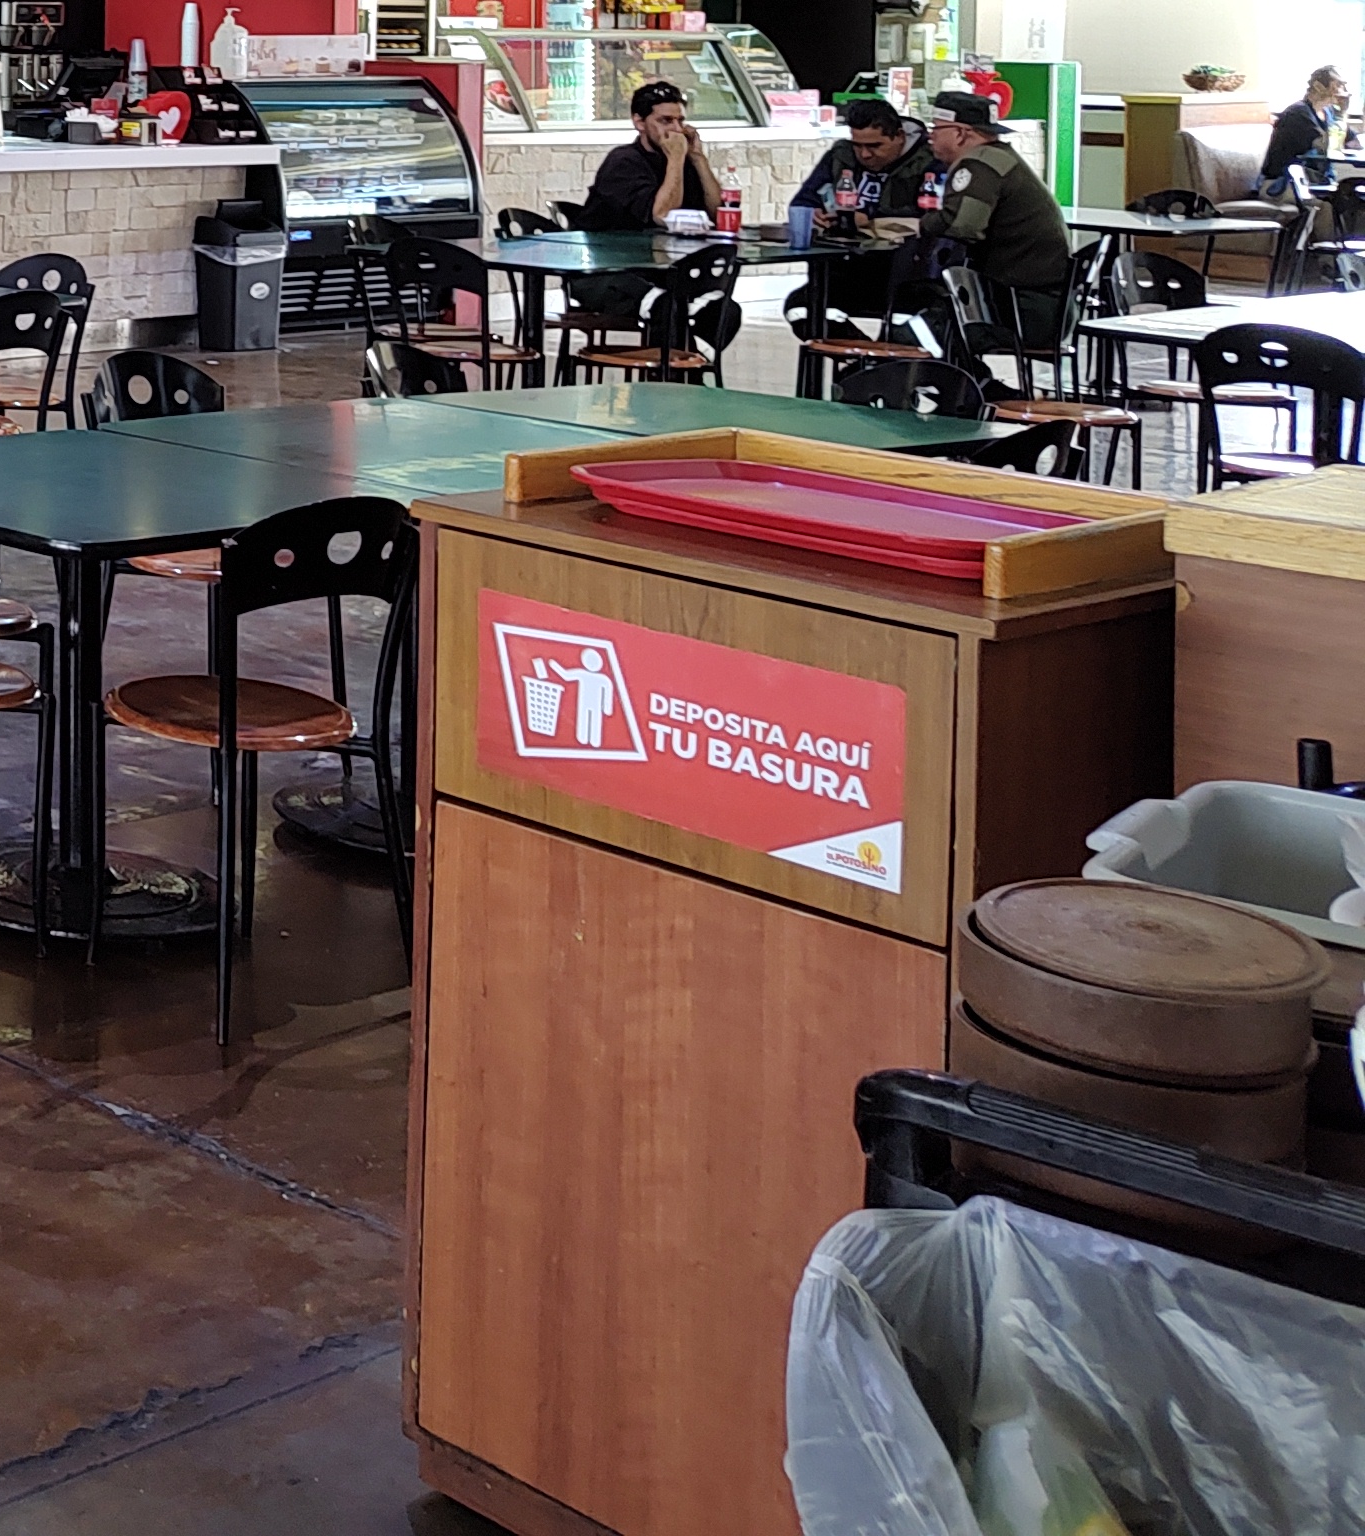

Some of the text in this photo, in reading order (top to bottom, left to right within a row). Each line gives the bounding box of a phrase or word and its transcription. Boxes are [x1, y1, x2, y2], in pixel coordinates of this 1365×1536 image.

[648, 721, 871, 810] TU BASURA
[649, 692, 872, 770] DEPOSITA AQUÍ
